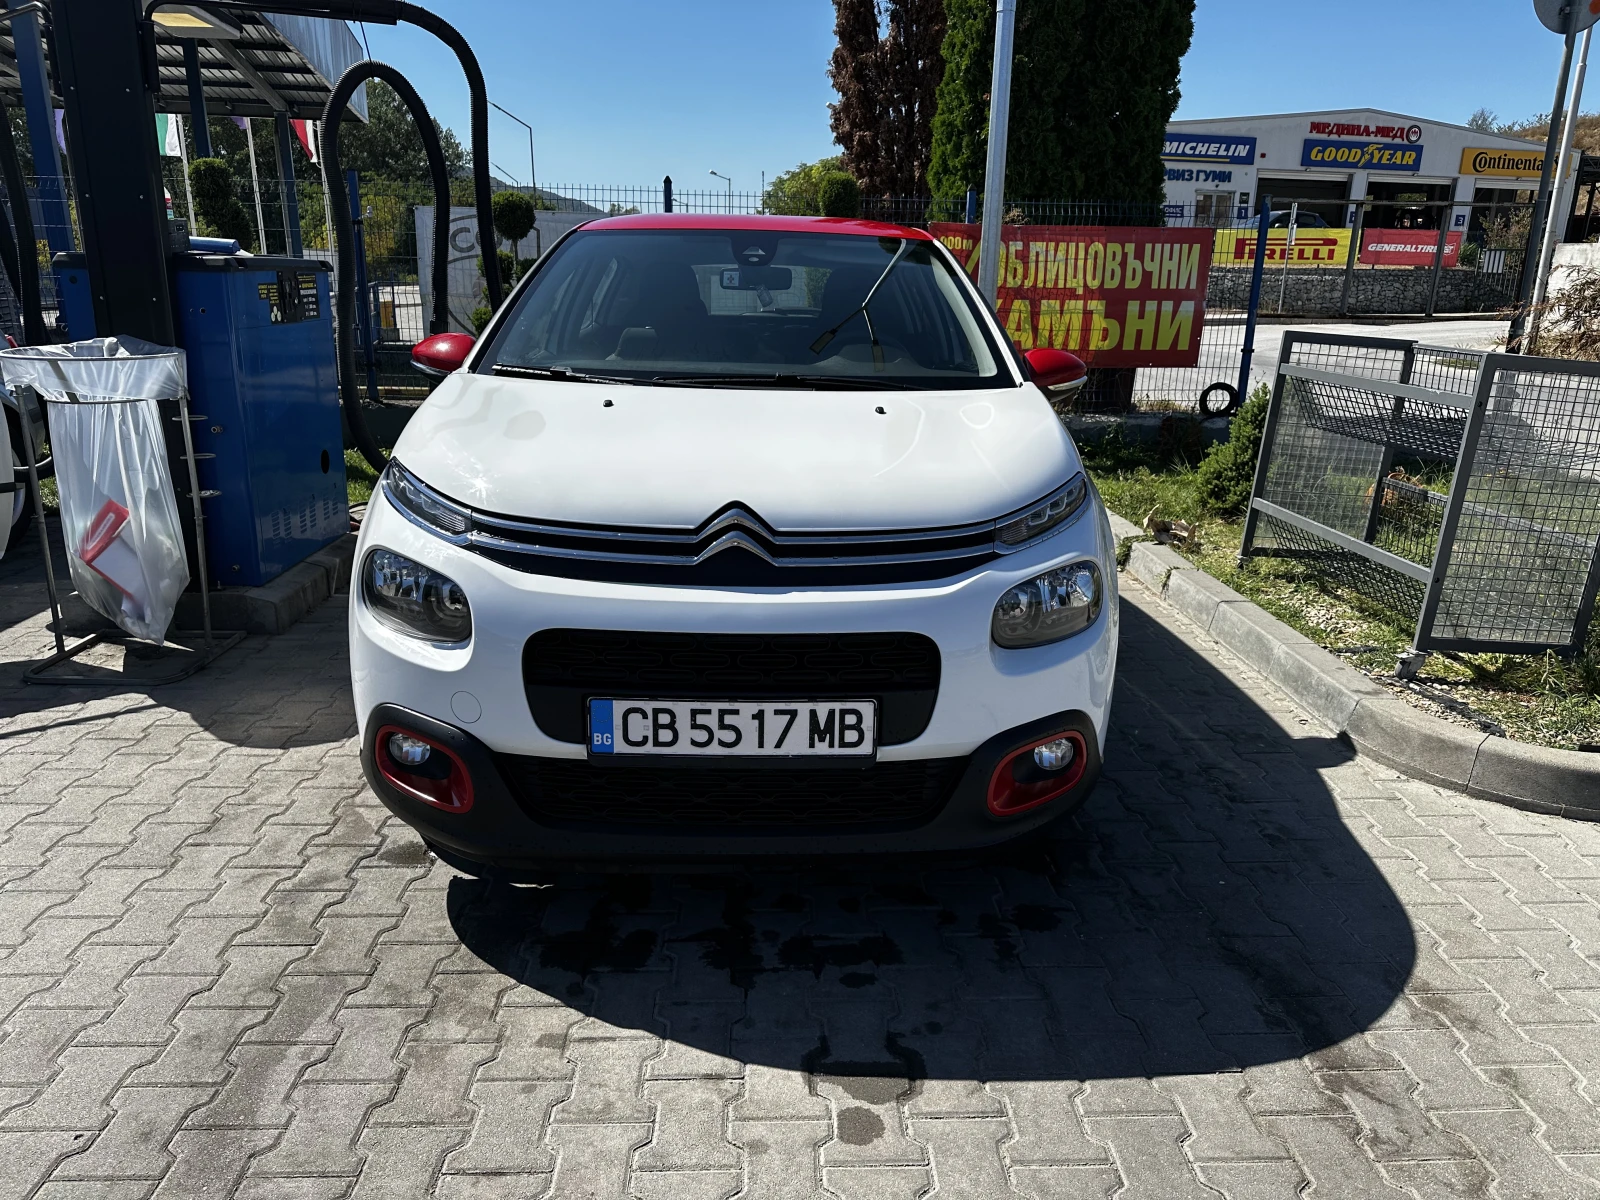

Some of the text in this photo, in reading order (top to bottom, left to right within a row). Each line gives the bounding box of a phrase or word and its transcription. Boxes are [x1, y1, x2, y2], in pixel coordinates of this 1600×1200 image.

[1162, 142, 1249, 157] MICHELIN
[1310, 145, 1416, 165] GOODYEAR
[1472, 152, 1543, 173] Continenta
[1196, 170, 1232, 183] ГУМИ
[1234, 238, 1338, 260] PIRELLI
[996, 299, 1194, 350] АМЪНИ
[621, 707, 865, 749] CB 5517 MB
[593, 733, 612, 745] BG
